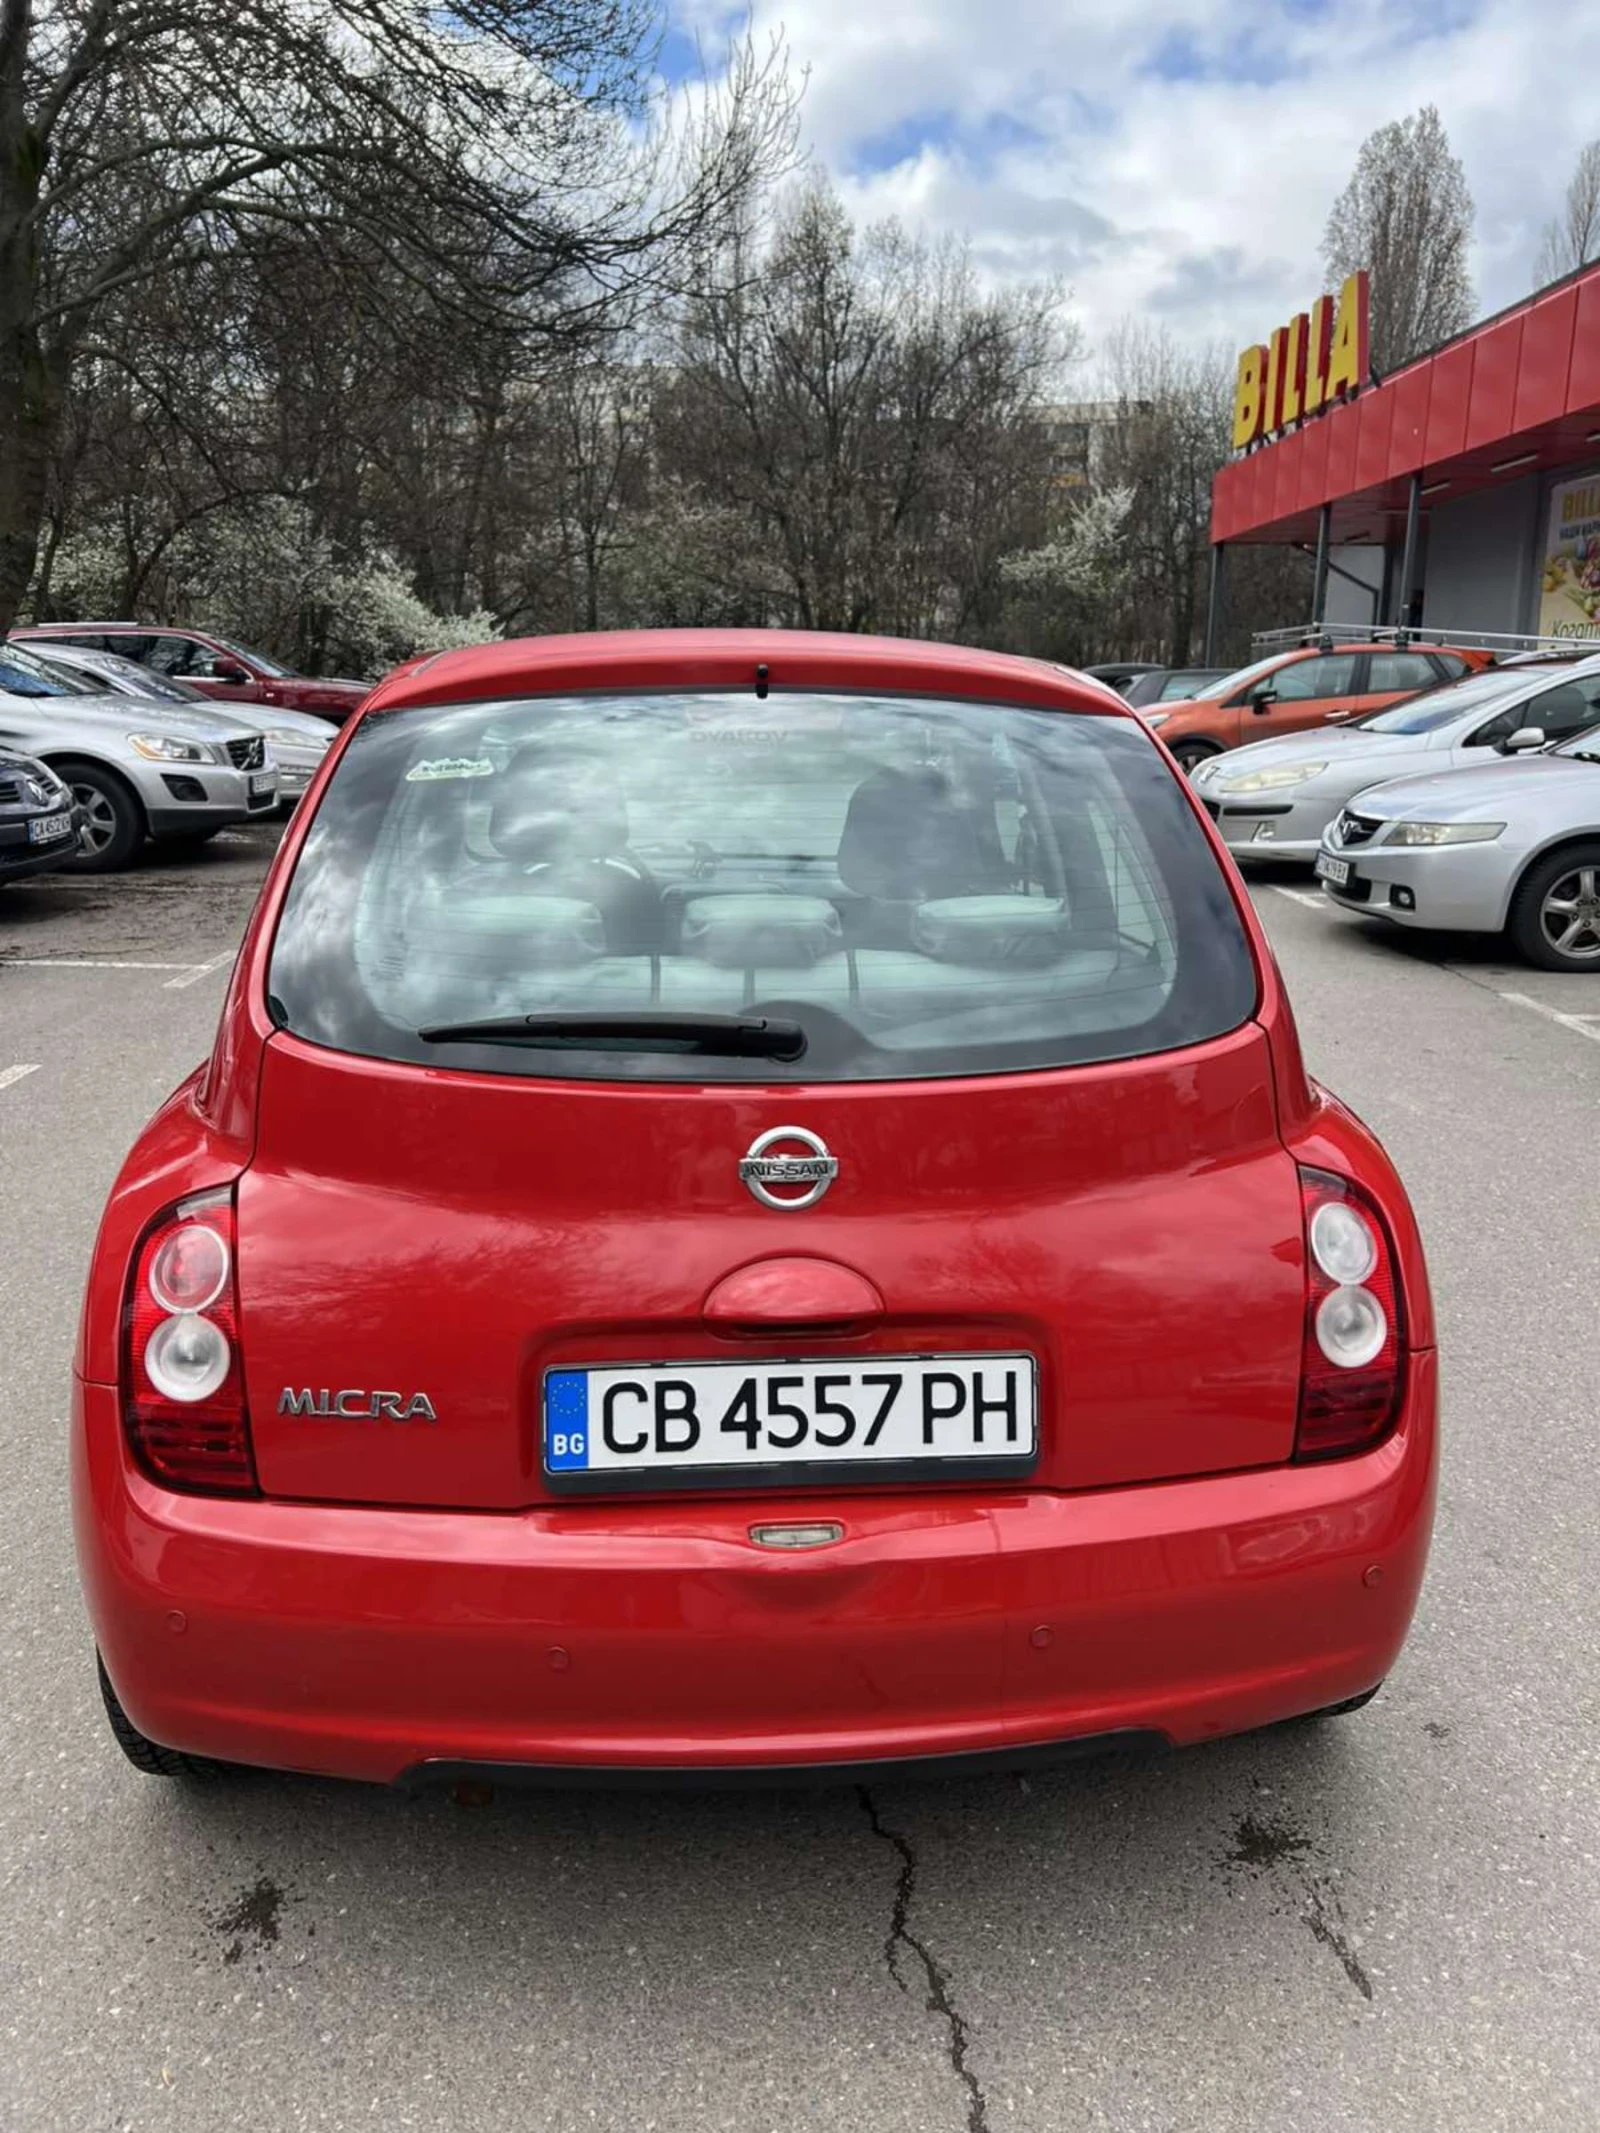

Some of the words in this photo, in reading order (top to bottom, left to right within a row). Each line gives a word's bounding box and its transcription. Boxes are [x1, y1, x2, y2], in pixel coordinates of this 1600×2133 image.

[1233, 270, 1367, 448] BILLA
[1563, 488, 1600, 523] BILL
[1551, 620, 1600, 639] Когат
[750, 1161, 829, 1176] NISSAN
[277, 1387, 437, 1420] MICRA
[602, 1381, 700, 1454] CB
[719, 1374, 903, 1450] 4557
[922, 1371, 1017, 1445] PH
[553, 1433, 585, 1456] BG
